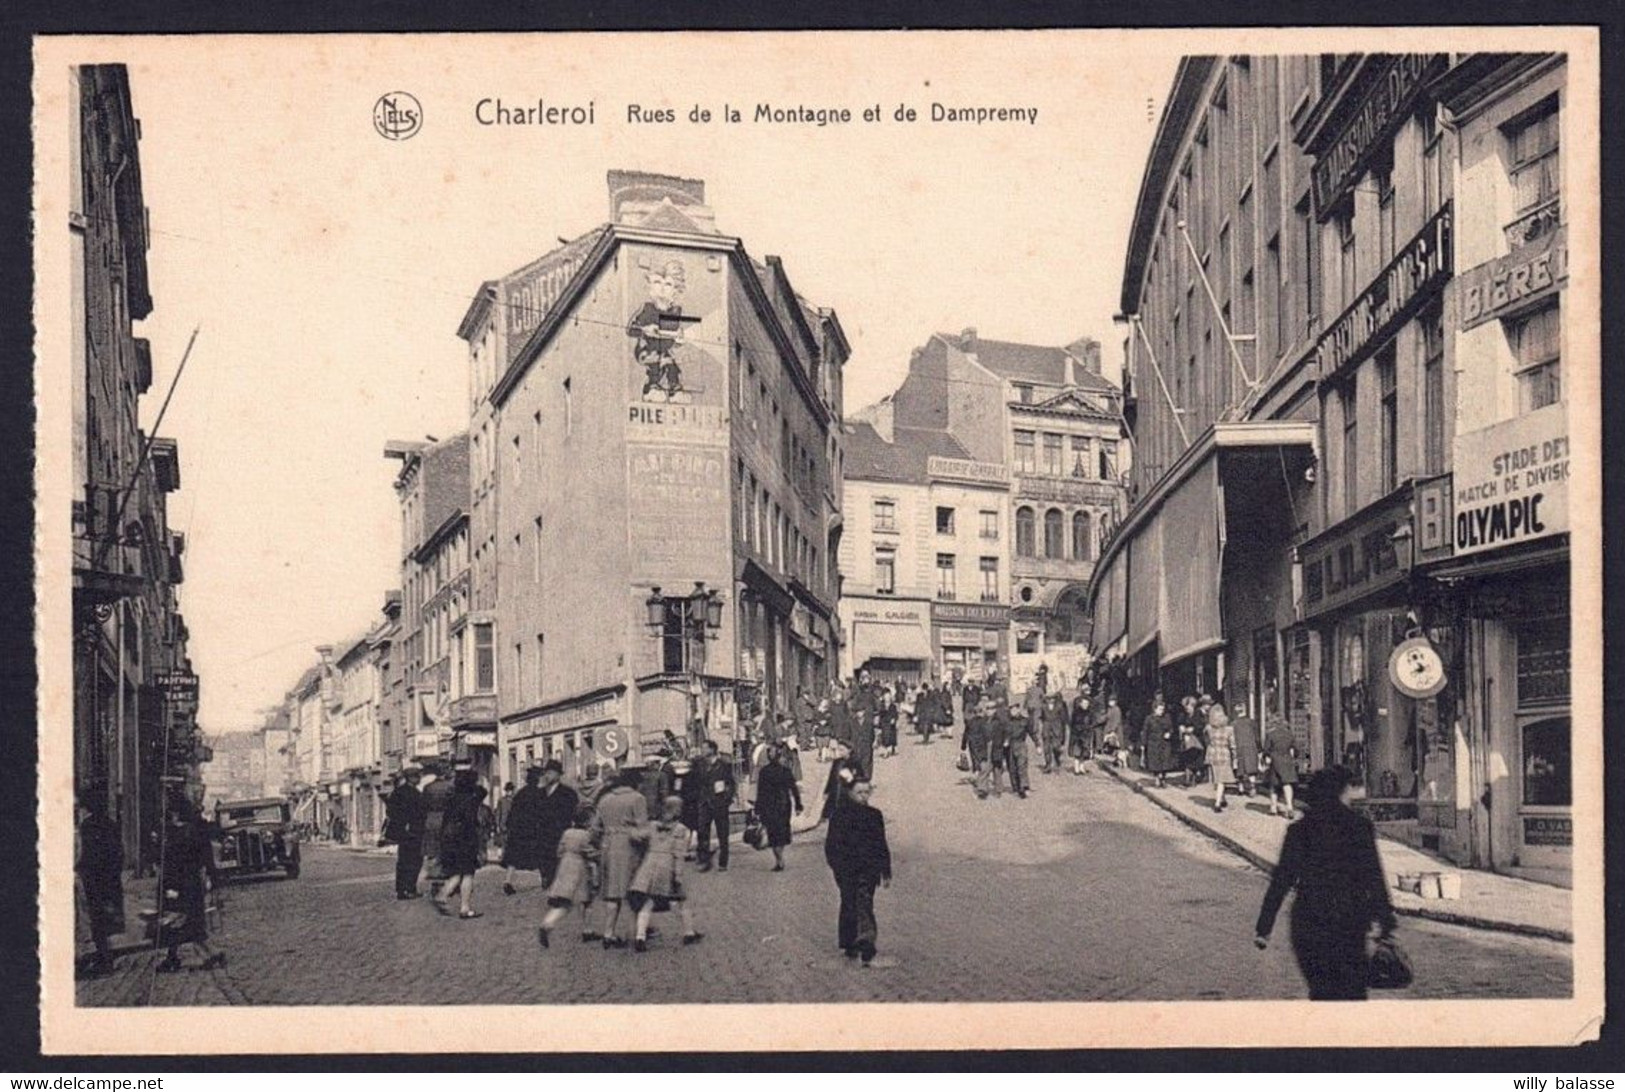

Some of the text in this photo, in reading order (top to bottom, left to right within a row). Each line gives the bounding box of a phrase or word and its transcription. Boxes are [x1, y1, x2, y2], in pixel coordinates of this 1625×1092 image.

[628, 406, 664, 425] PILE
[1492, 445, 1538, 476] STADE
[1457, 481, 1498, 505] MATCH
[1504, 474, 1519, 495] DE
[1456, 492, 1546, 549] OLYMPIC
[604, 731, 619, 753] S
